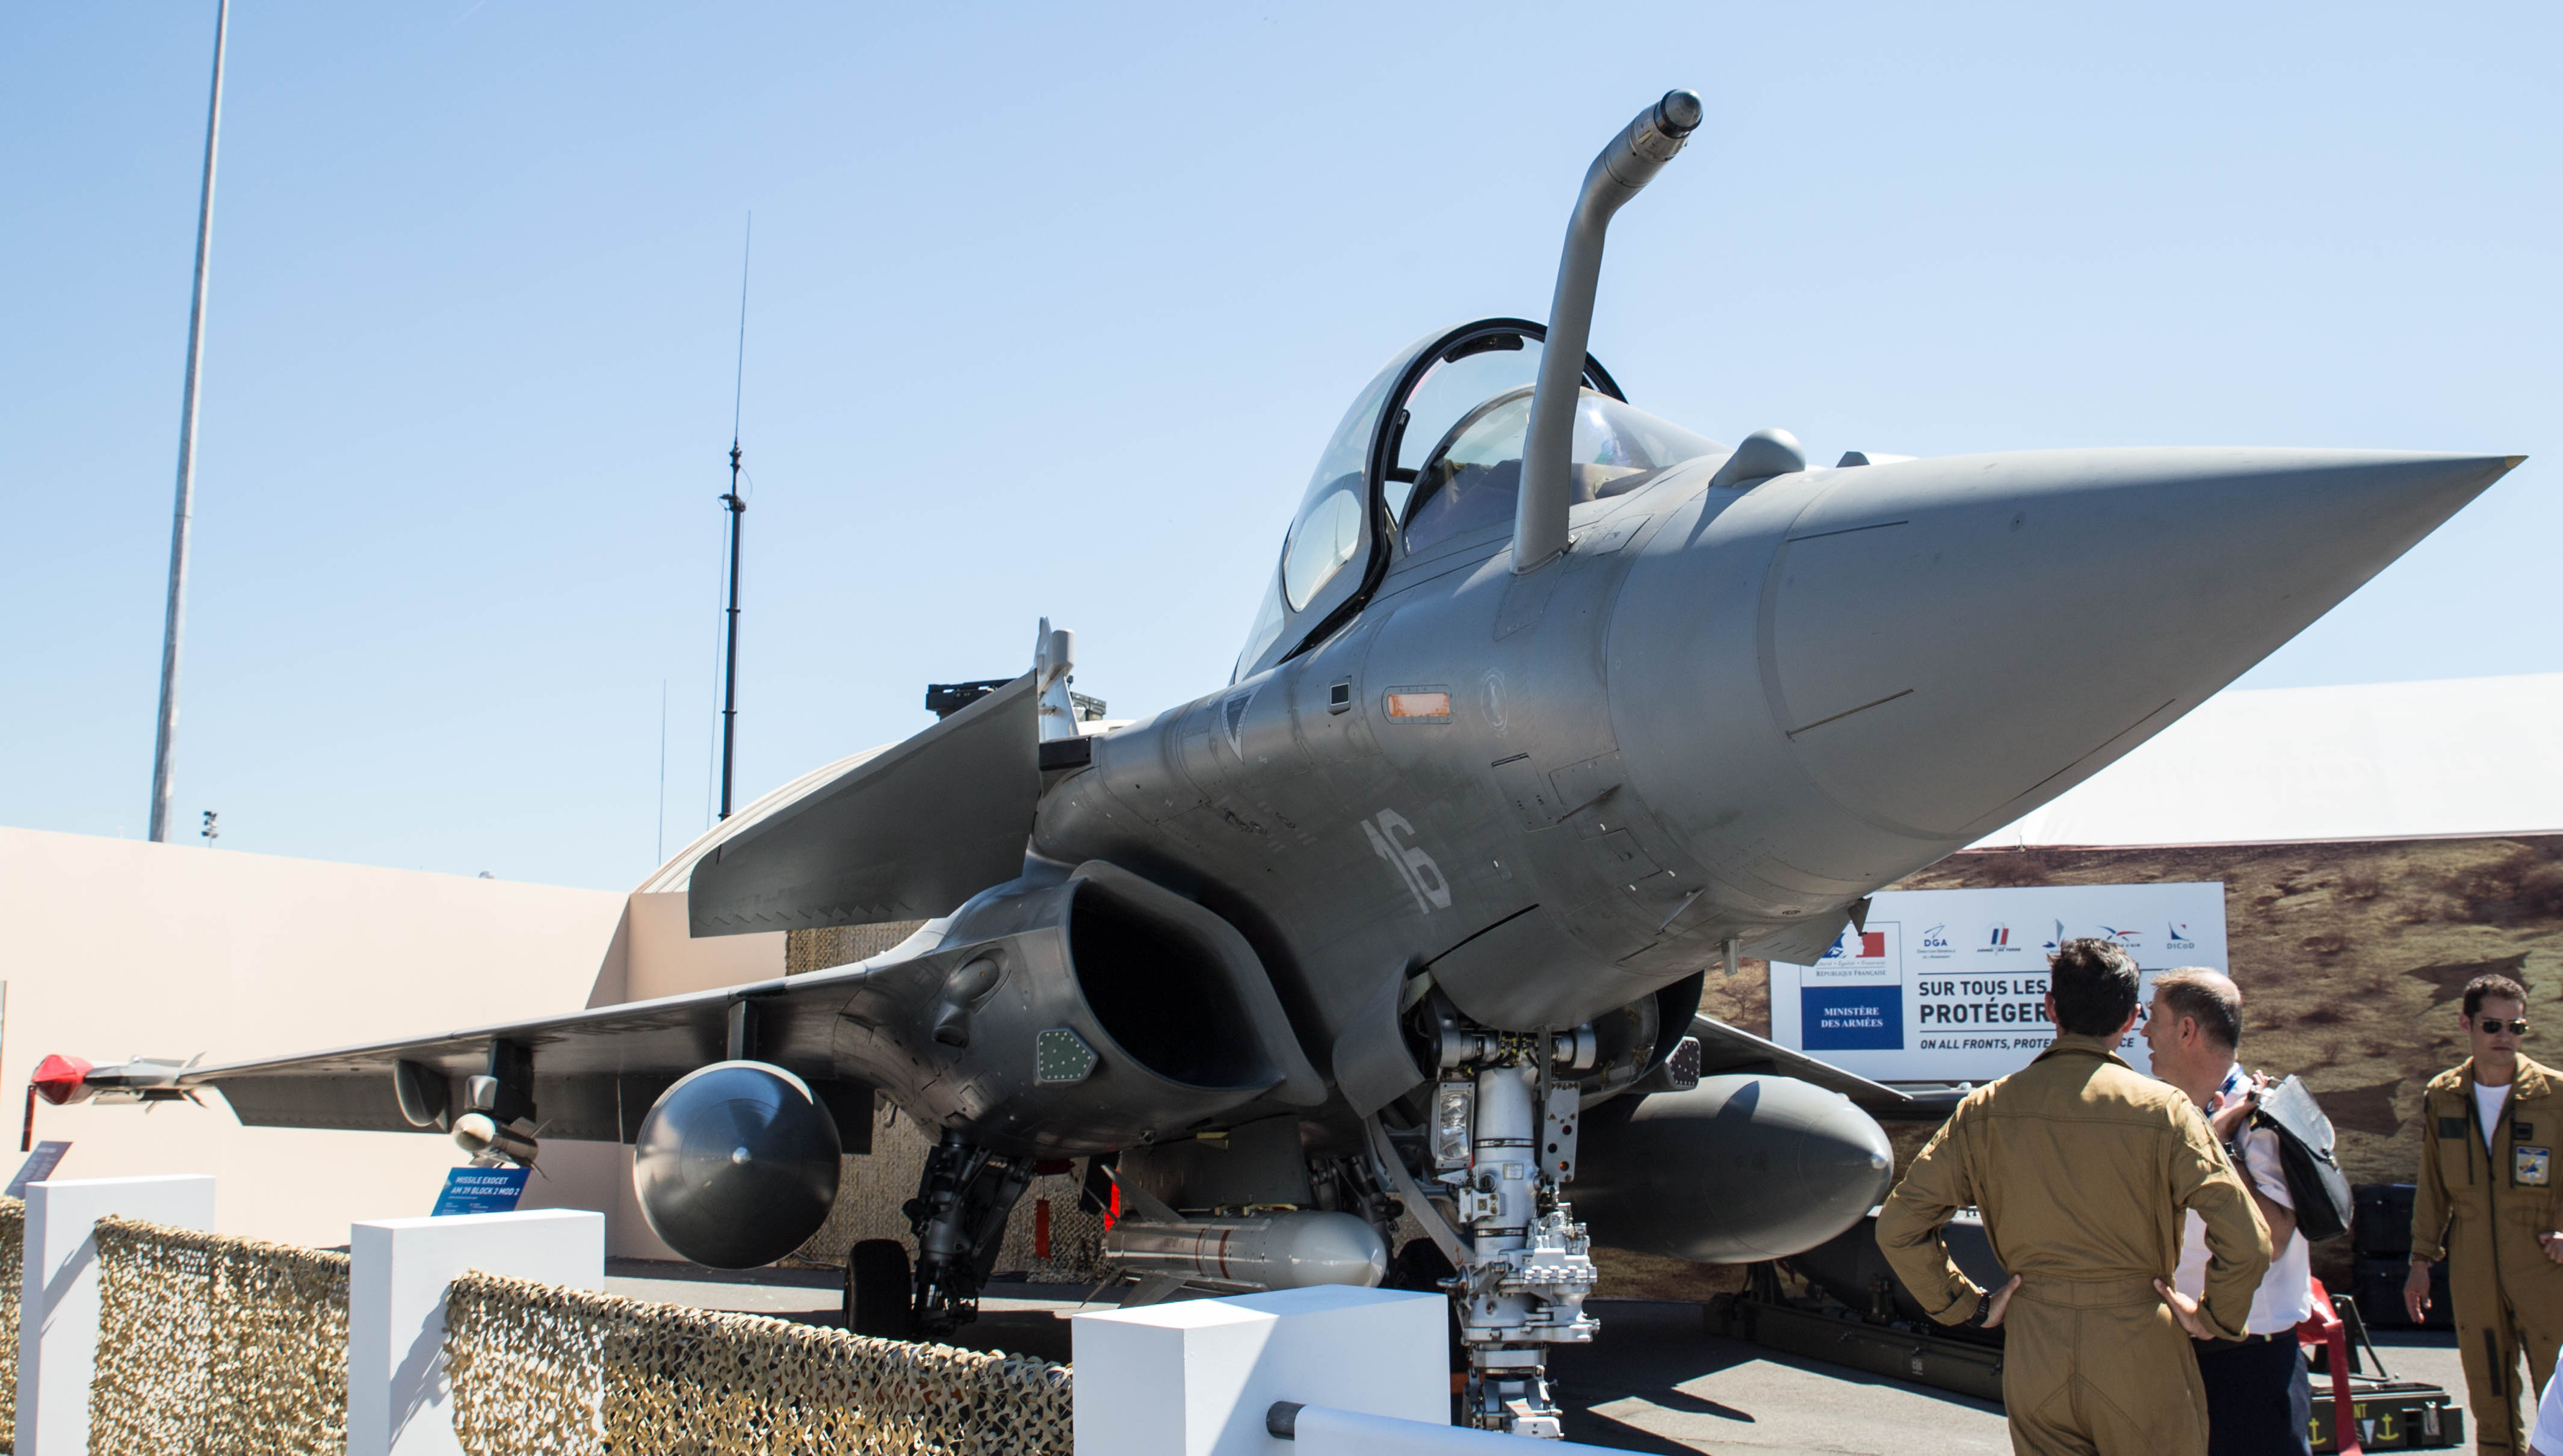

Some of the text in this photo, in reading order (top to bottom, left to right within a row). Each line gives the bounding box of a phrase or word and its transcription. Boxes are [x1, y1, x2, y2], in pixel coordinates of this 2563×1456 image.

[1360, 807, 1452, 915] 16
[1919, 979, 2047, 996] SUR TOUS LES
[1824, 1005, 1879, 1016] MINISTÈRE
[1920, 997, 2050, 1023] PROTÉGER
[1821, 1017, 1883, 1028] DES ARMÉES
[1920, 1040, 1936, 1049] ON
[1938, 1039, 1959, 1049] ALL
[1962, 1038, 2010, 1050] FRONTS,
[455, 1176, 509, 1185] MISSILE EXOCET
[515, 1188, 521, 1196] 2
